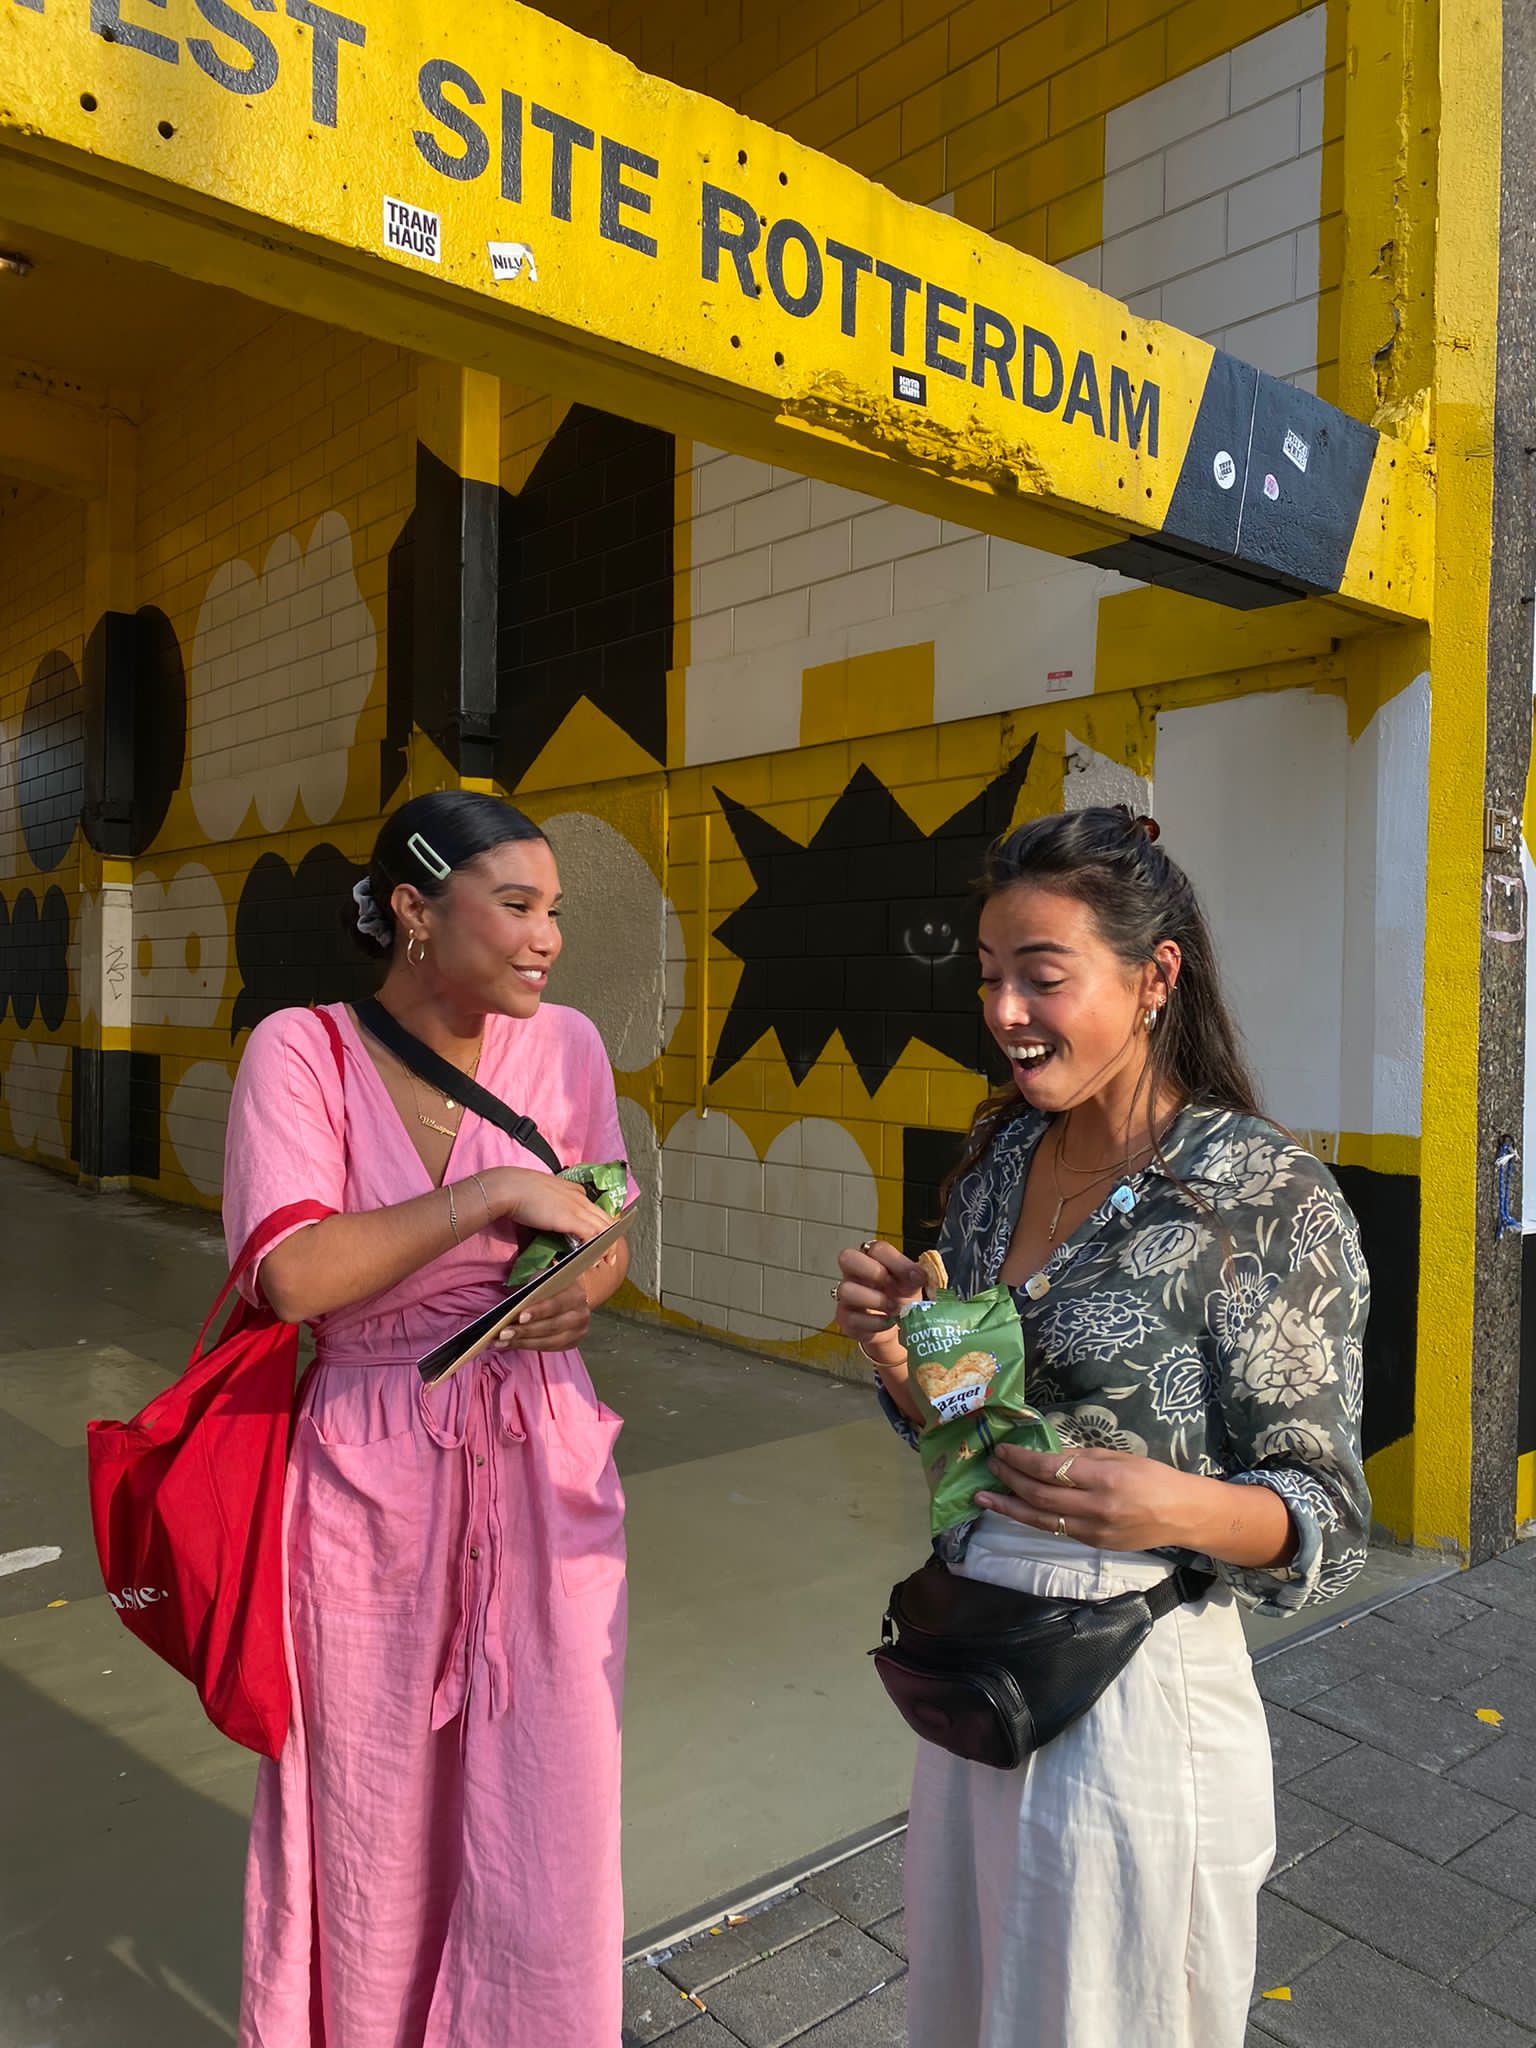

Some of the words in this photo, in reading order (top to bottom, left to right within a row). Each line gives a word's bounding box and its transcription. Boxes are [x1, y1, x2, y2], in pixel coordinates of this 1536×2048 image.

[386, 201, 438, 237] TRAM
[388, 223, 436, 257] HAUS
[411, 58, 660, 259] SITE
[699, 182, 1161, 459] ROTTERDAM
[906, 1327, 943, 1346] rown
[917, 1335, 962, 1357] Chips
